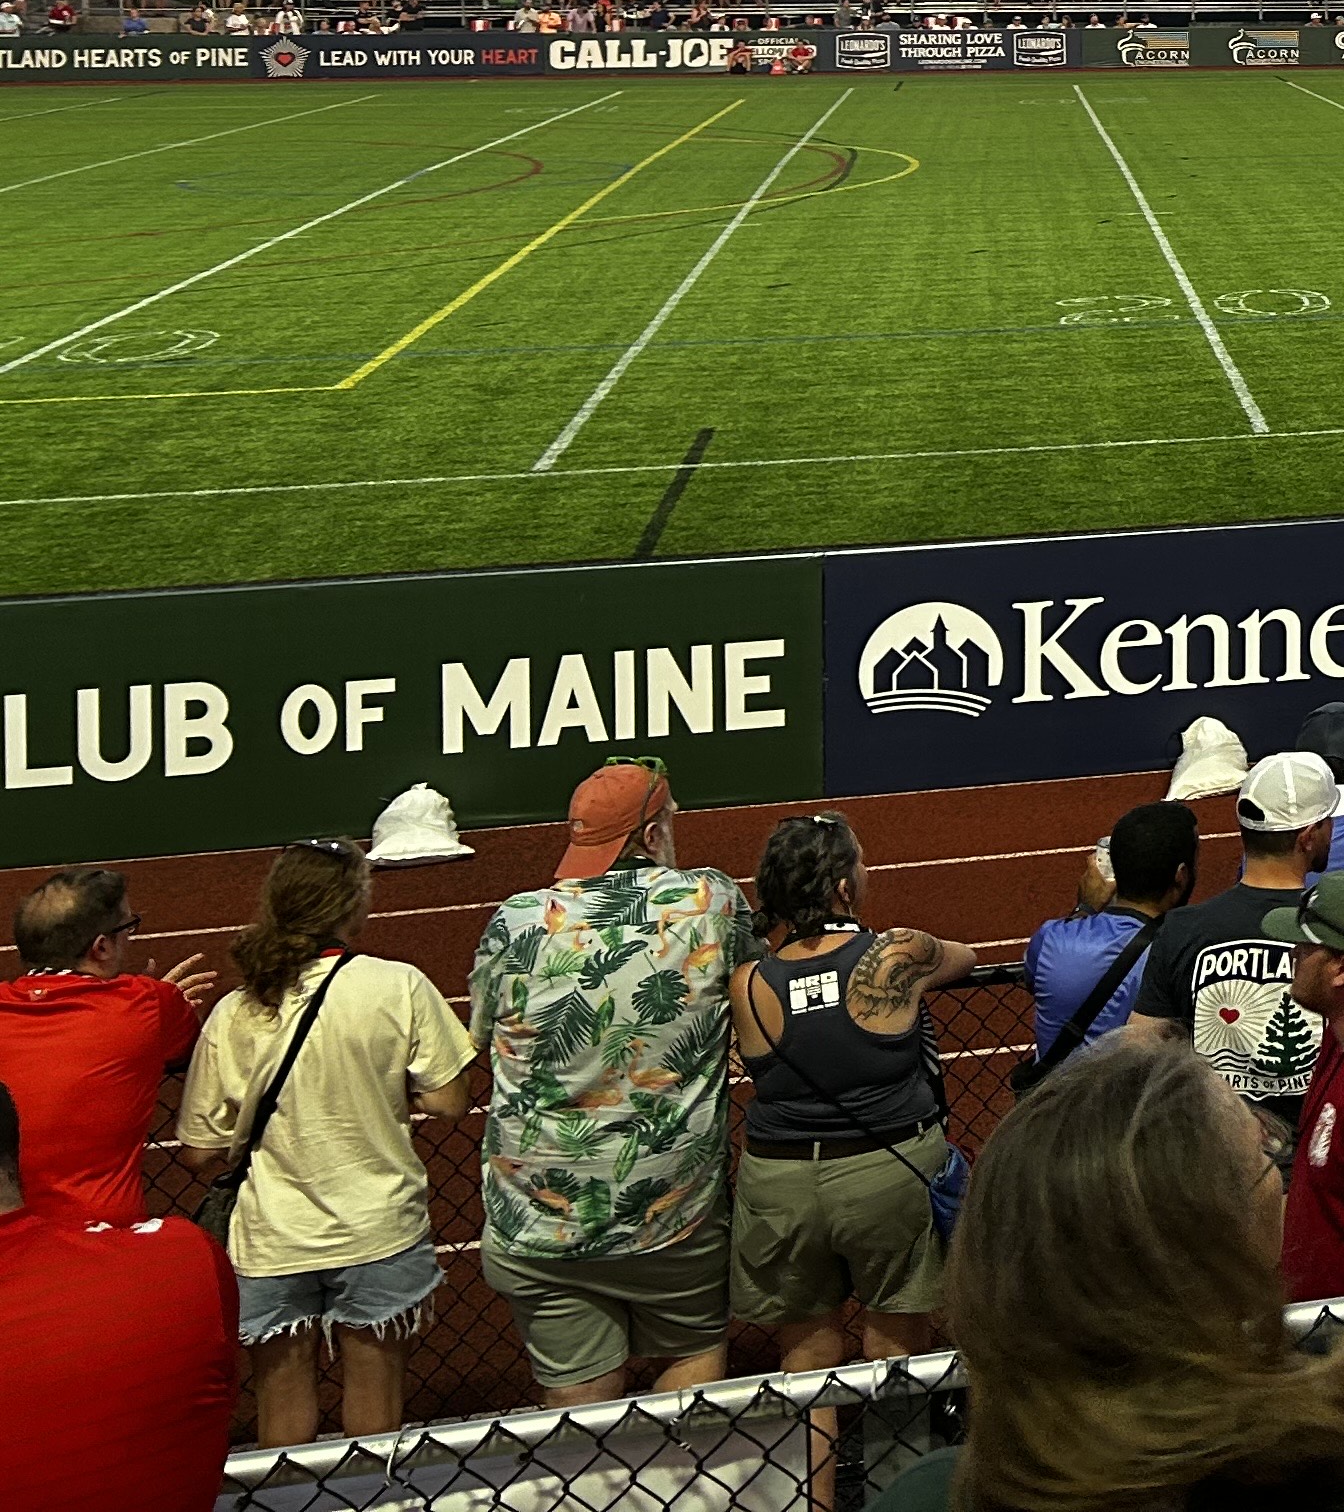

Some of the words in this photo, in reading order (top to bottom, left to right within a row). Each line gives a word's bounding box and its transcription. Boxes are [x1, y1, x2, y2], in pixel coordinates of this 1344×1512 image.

[899, 33, 962, 45] SHARING
[966, 33, 1003, 44] LOVE
[73, 48, 162, 68] HEARTS
[196, 47, 249, 67] PINE
[320, 50, 368, 67] LEAD
[373, 49, 421, 67] WITH
[427, 49, 475, 66] YOUR
[481, 48, 539, 65] HEART
[899, 47, 962, 58] THROUGH
[966, 46, 1006, 57] PIZZA
[1135, 50, 1190, 60] ACORN
[1246, 49, 1300, 59] ACORN
[3, 681, 235, 790] LUB
[279, 677, 397, 756] OF
[441, 638, 787, 755] MAINE
[1198, 947, 1295, 987] PORTLA
